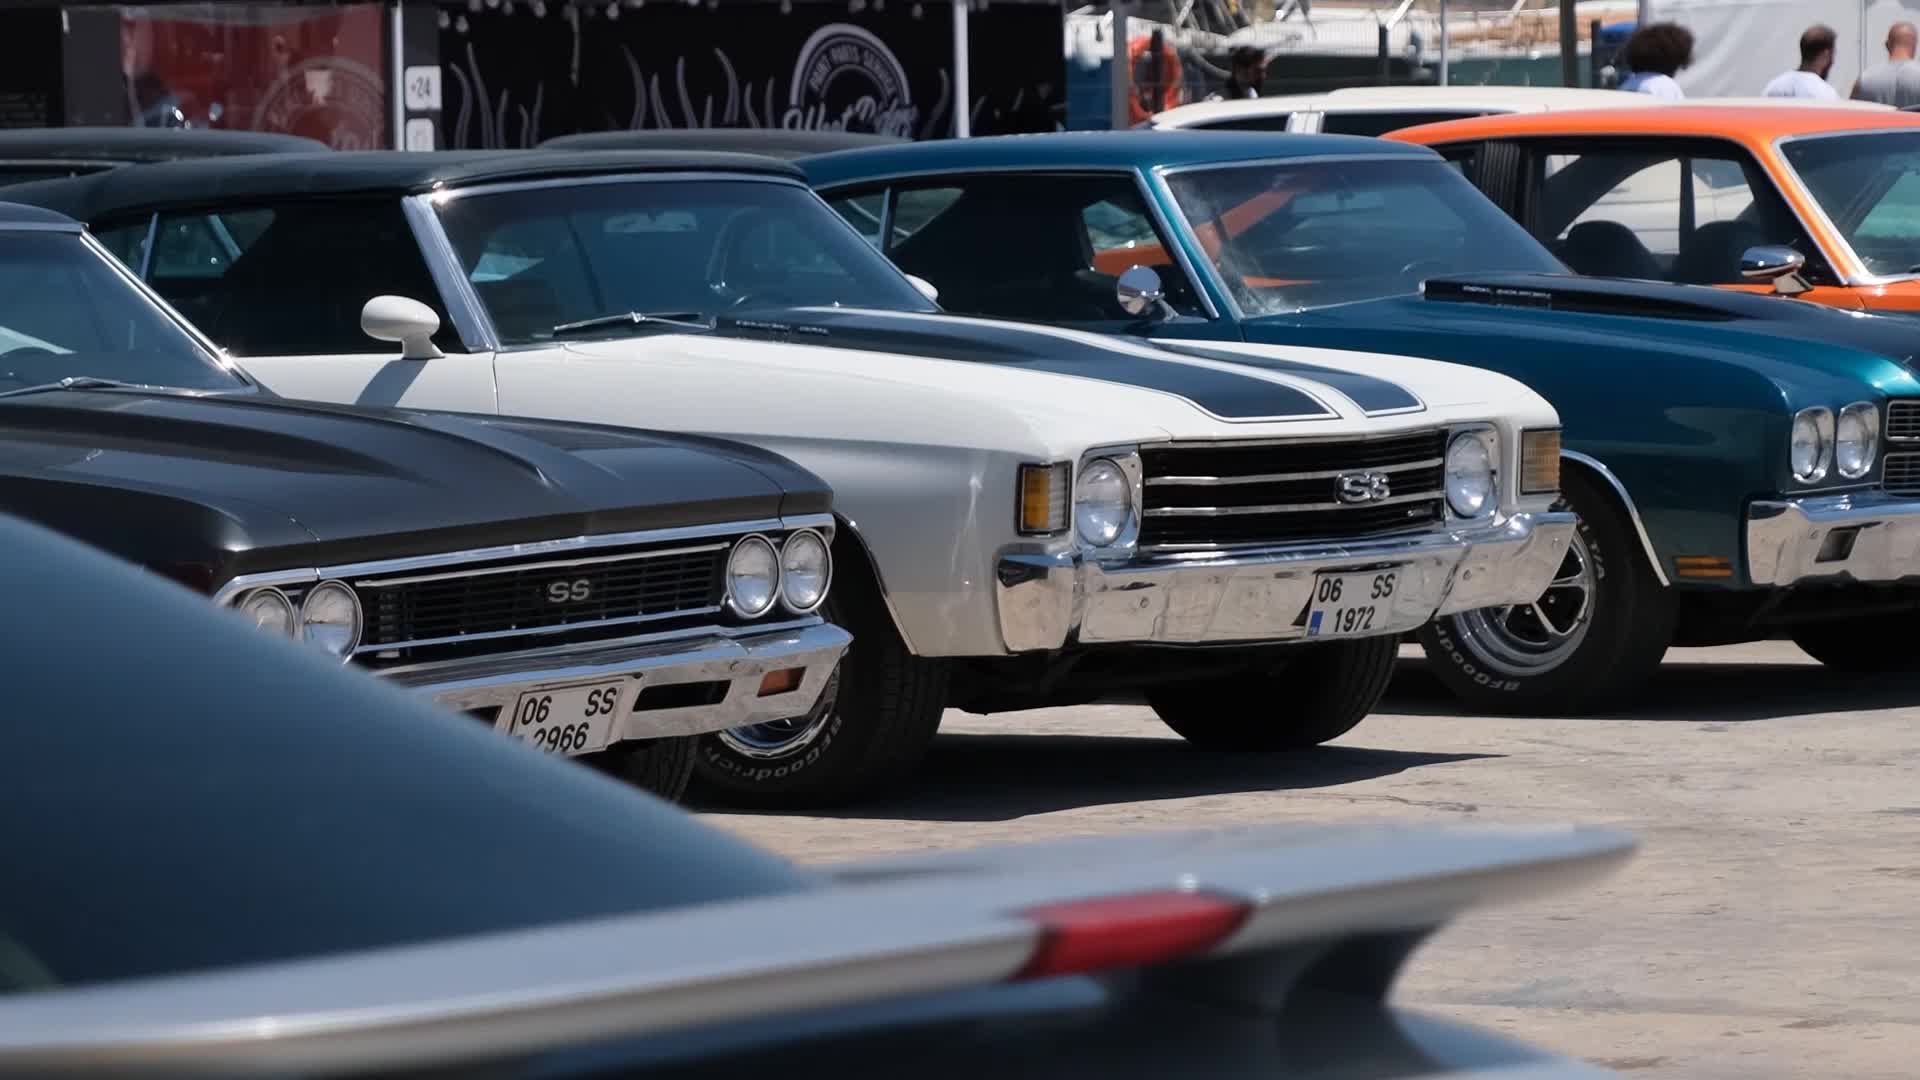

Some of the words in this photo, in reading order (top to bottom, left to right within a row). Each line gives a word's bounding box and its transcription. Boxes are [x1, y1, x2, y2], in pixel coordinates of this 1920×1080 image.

[1343, 474, 1390, 501] SS
[547, 579, 590, 602] SS
[1318, 577, 1343, 602] 06
[1370, 573, 1396, 599] SS
[1335, 606, 1375, 633] 1972
[521, 695, 552, 725] 06
[585, 687, 617, 717] SS
[533, 722, 590, 753] 2966
